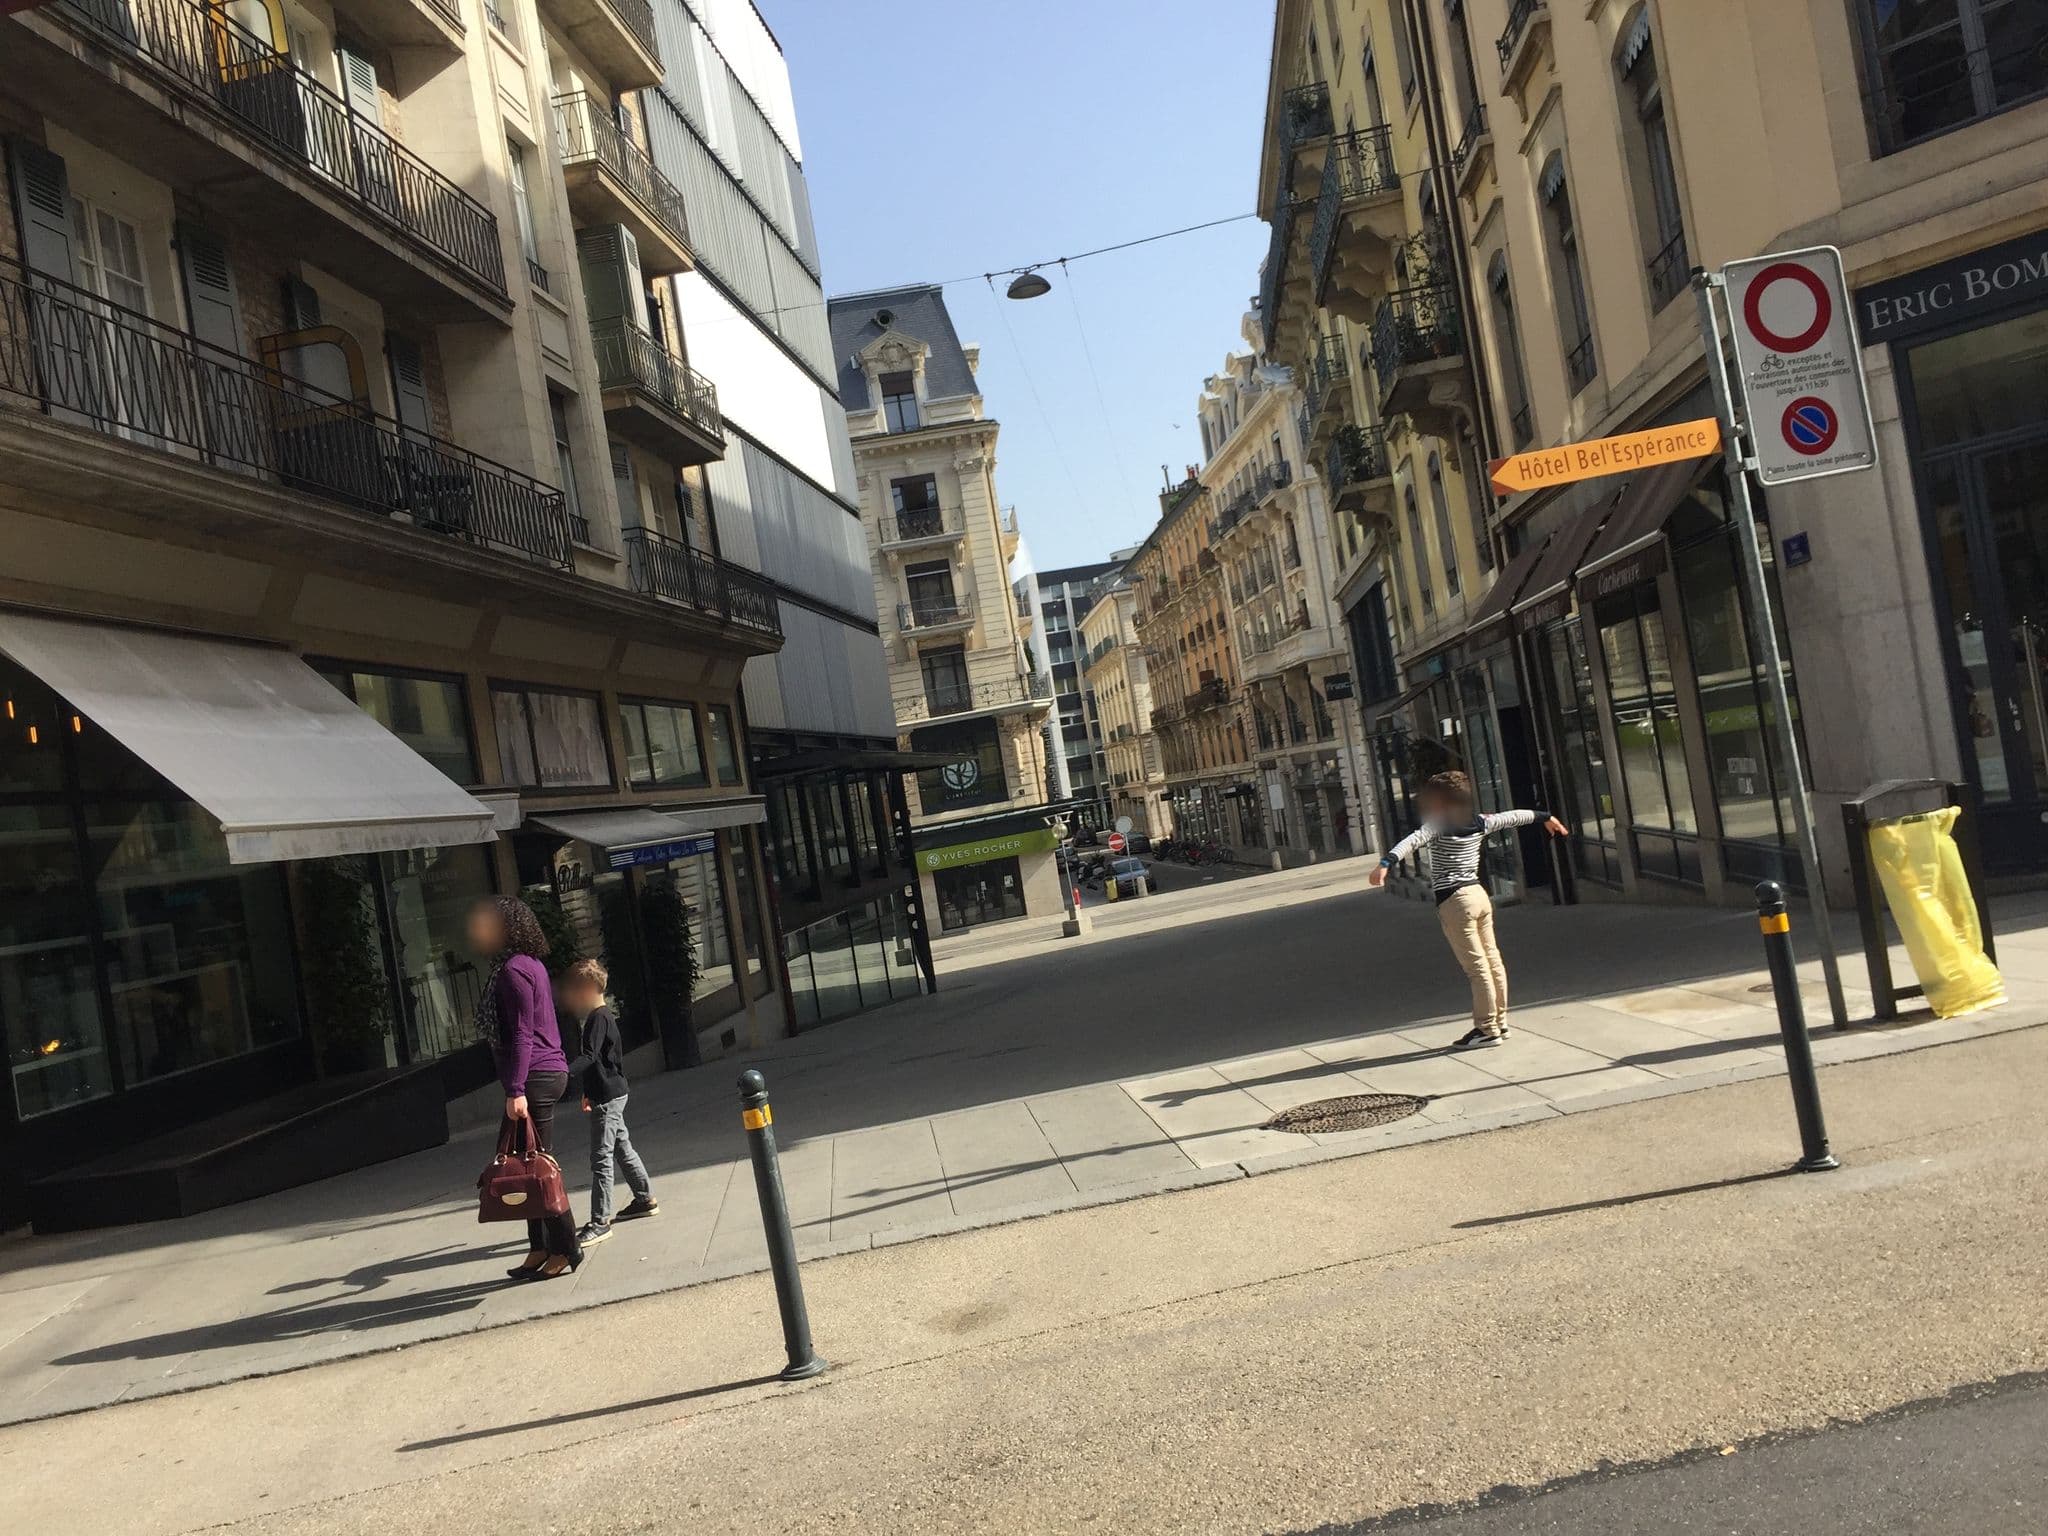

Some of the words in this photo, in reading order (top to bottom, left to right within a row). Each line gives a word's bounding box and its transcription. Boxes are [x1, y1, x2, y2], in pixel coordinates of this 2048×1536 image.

[1866, 283, 1953, 329] ERIC
[1824, 352, 1832, 360] et
[1794, 374, 1807, 383] des
[1518, 453, 1571, 481] Hôtel
[1577, 430, 1707, 470] Bel'Espérance
[941, 849, 970, 861] YVES
[974, 840, 1021, 856] ROCHER
